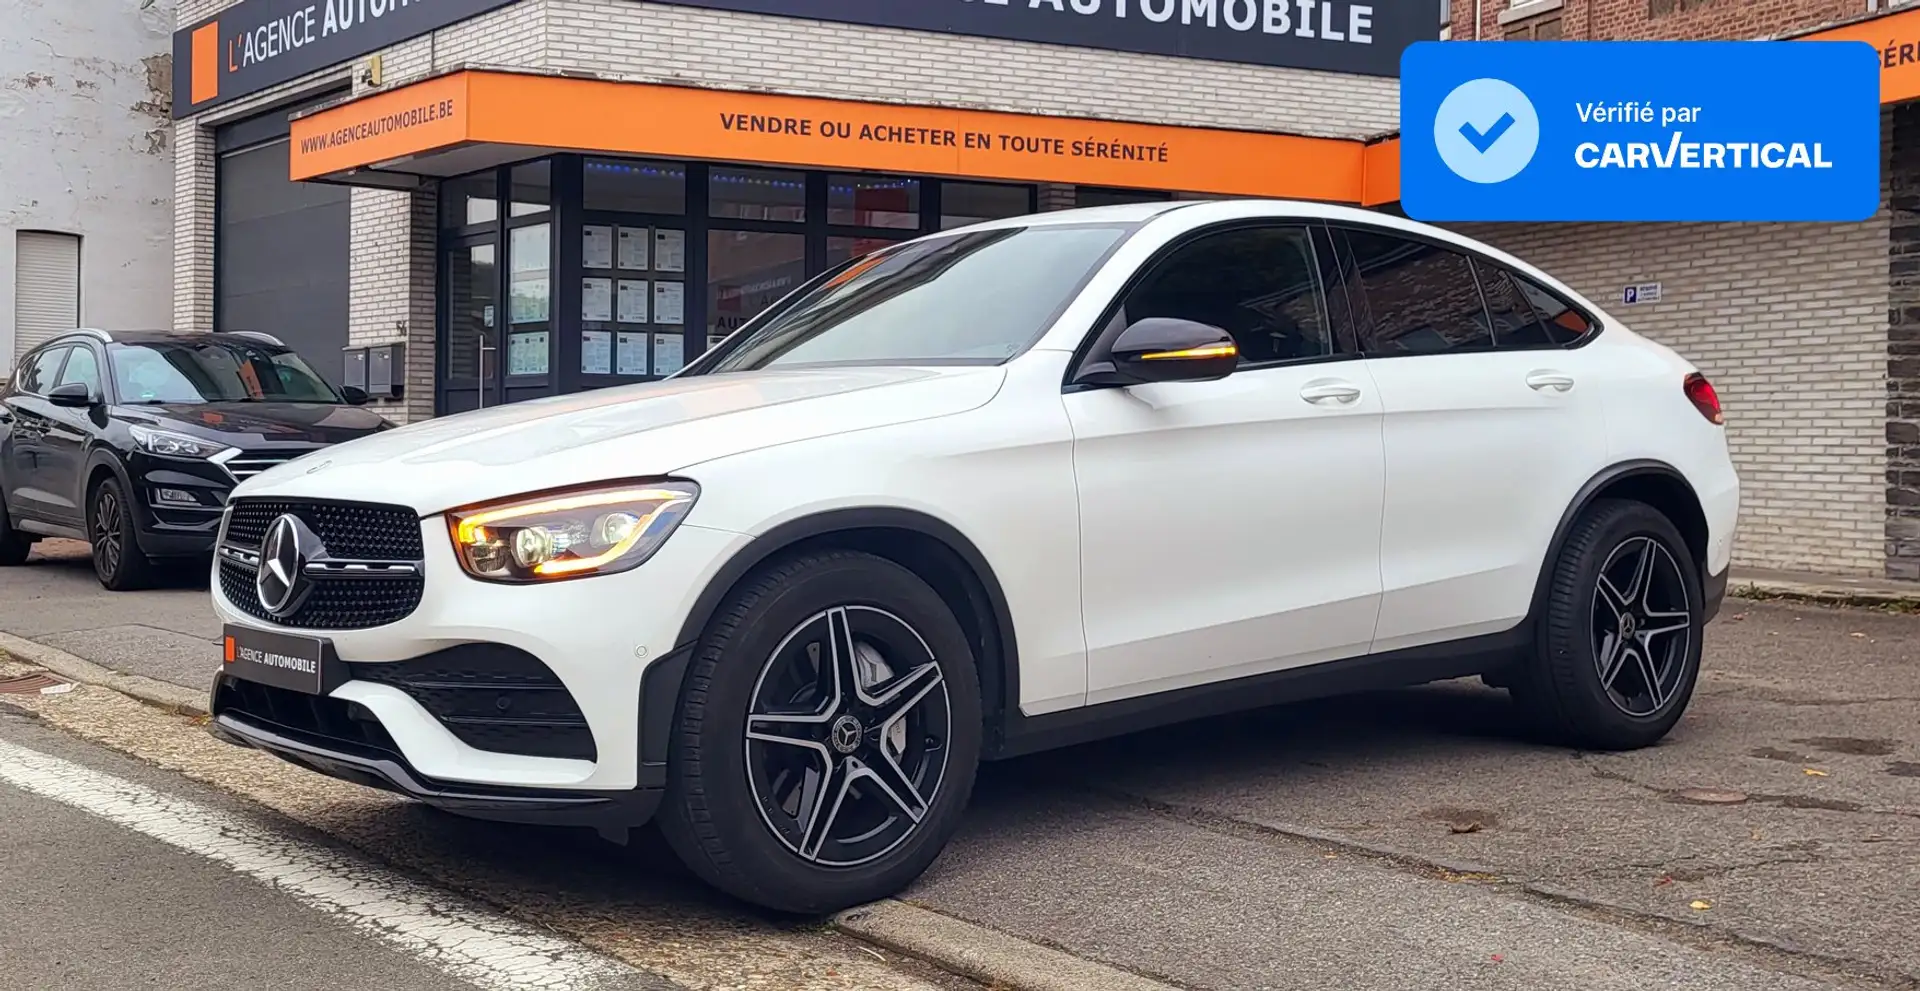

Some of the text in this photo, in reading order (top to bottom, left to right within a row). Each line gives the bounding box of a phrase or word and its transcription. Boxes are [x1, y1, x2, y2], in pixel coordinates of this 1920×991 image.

[229, 6, 315, 72] L'AGENCE
[1028, 0, 1374, 44] OMOBILE
[1877, 39, 1920, 69] ÉR
[301, 99, 453, 154] WWW.AGENCEAUTOMOBILE.BE
[720, 113, 1168, 162] VENDRE OU ACHETER EN TOUTE SÉRÉNITÉ
[263, 652, 317, 674] AUTOMOBILE
